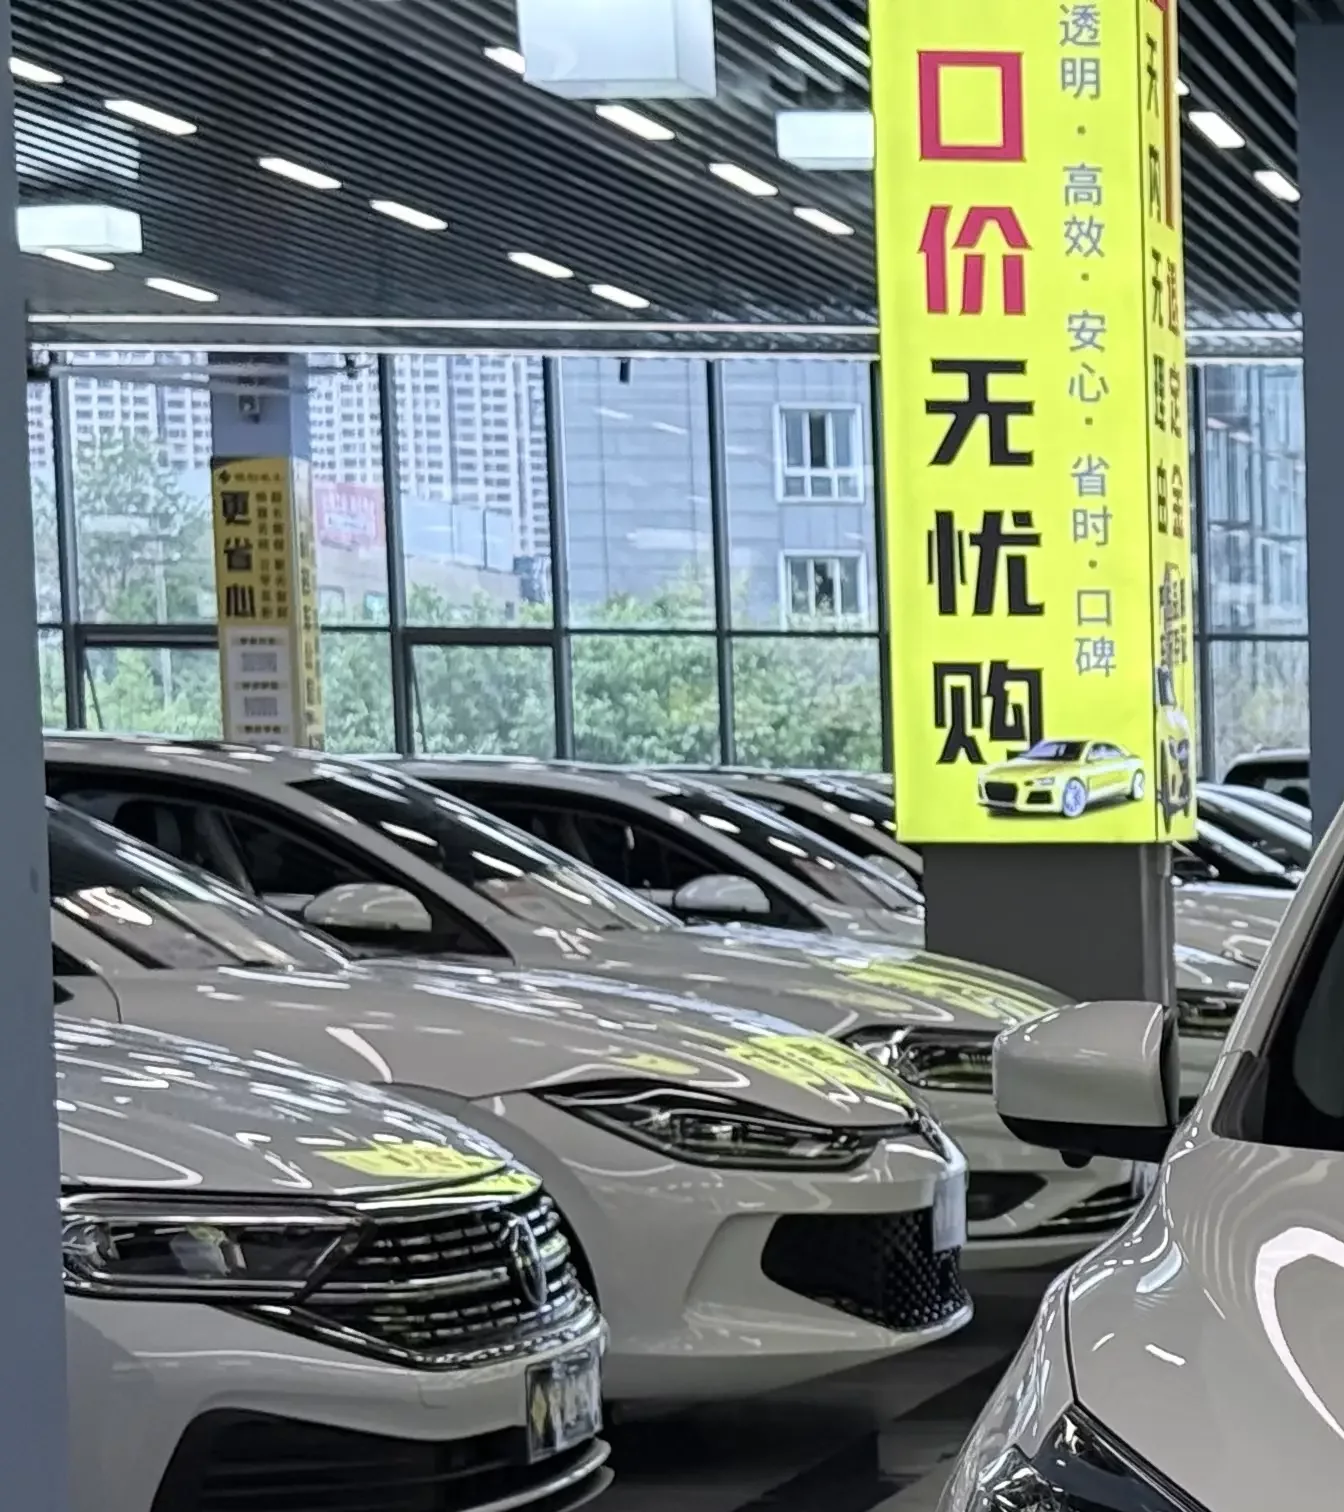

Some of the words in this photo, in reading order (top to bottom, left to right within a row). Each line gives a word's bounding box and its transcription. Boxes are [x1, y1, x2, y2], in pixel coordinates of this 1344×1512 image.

[918, 50, 1045, 765] 口价无忧购
